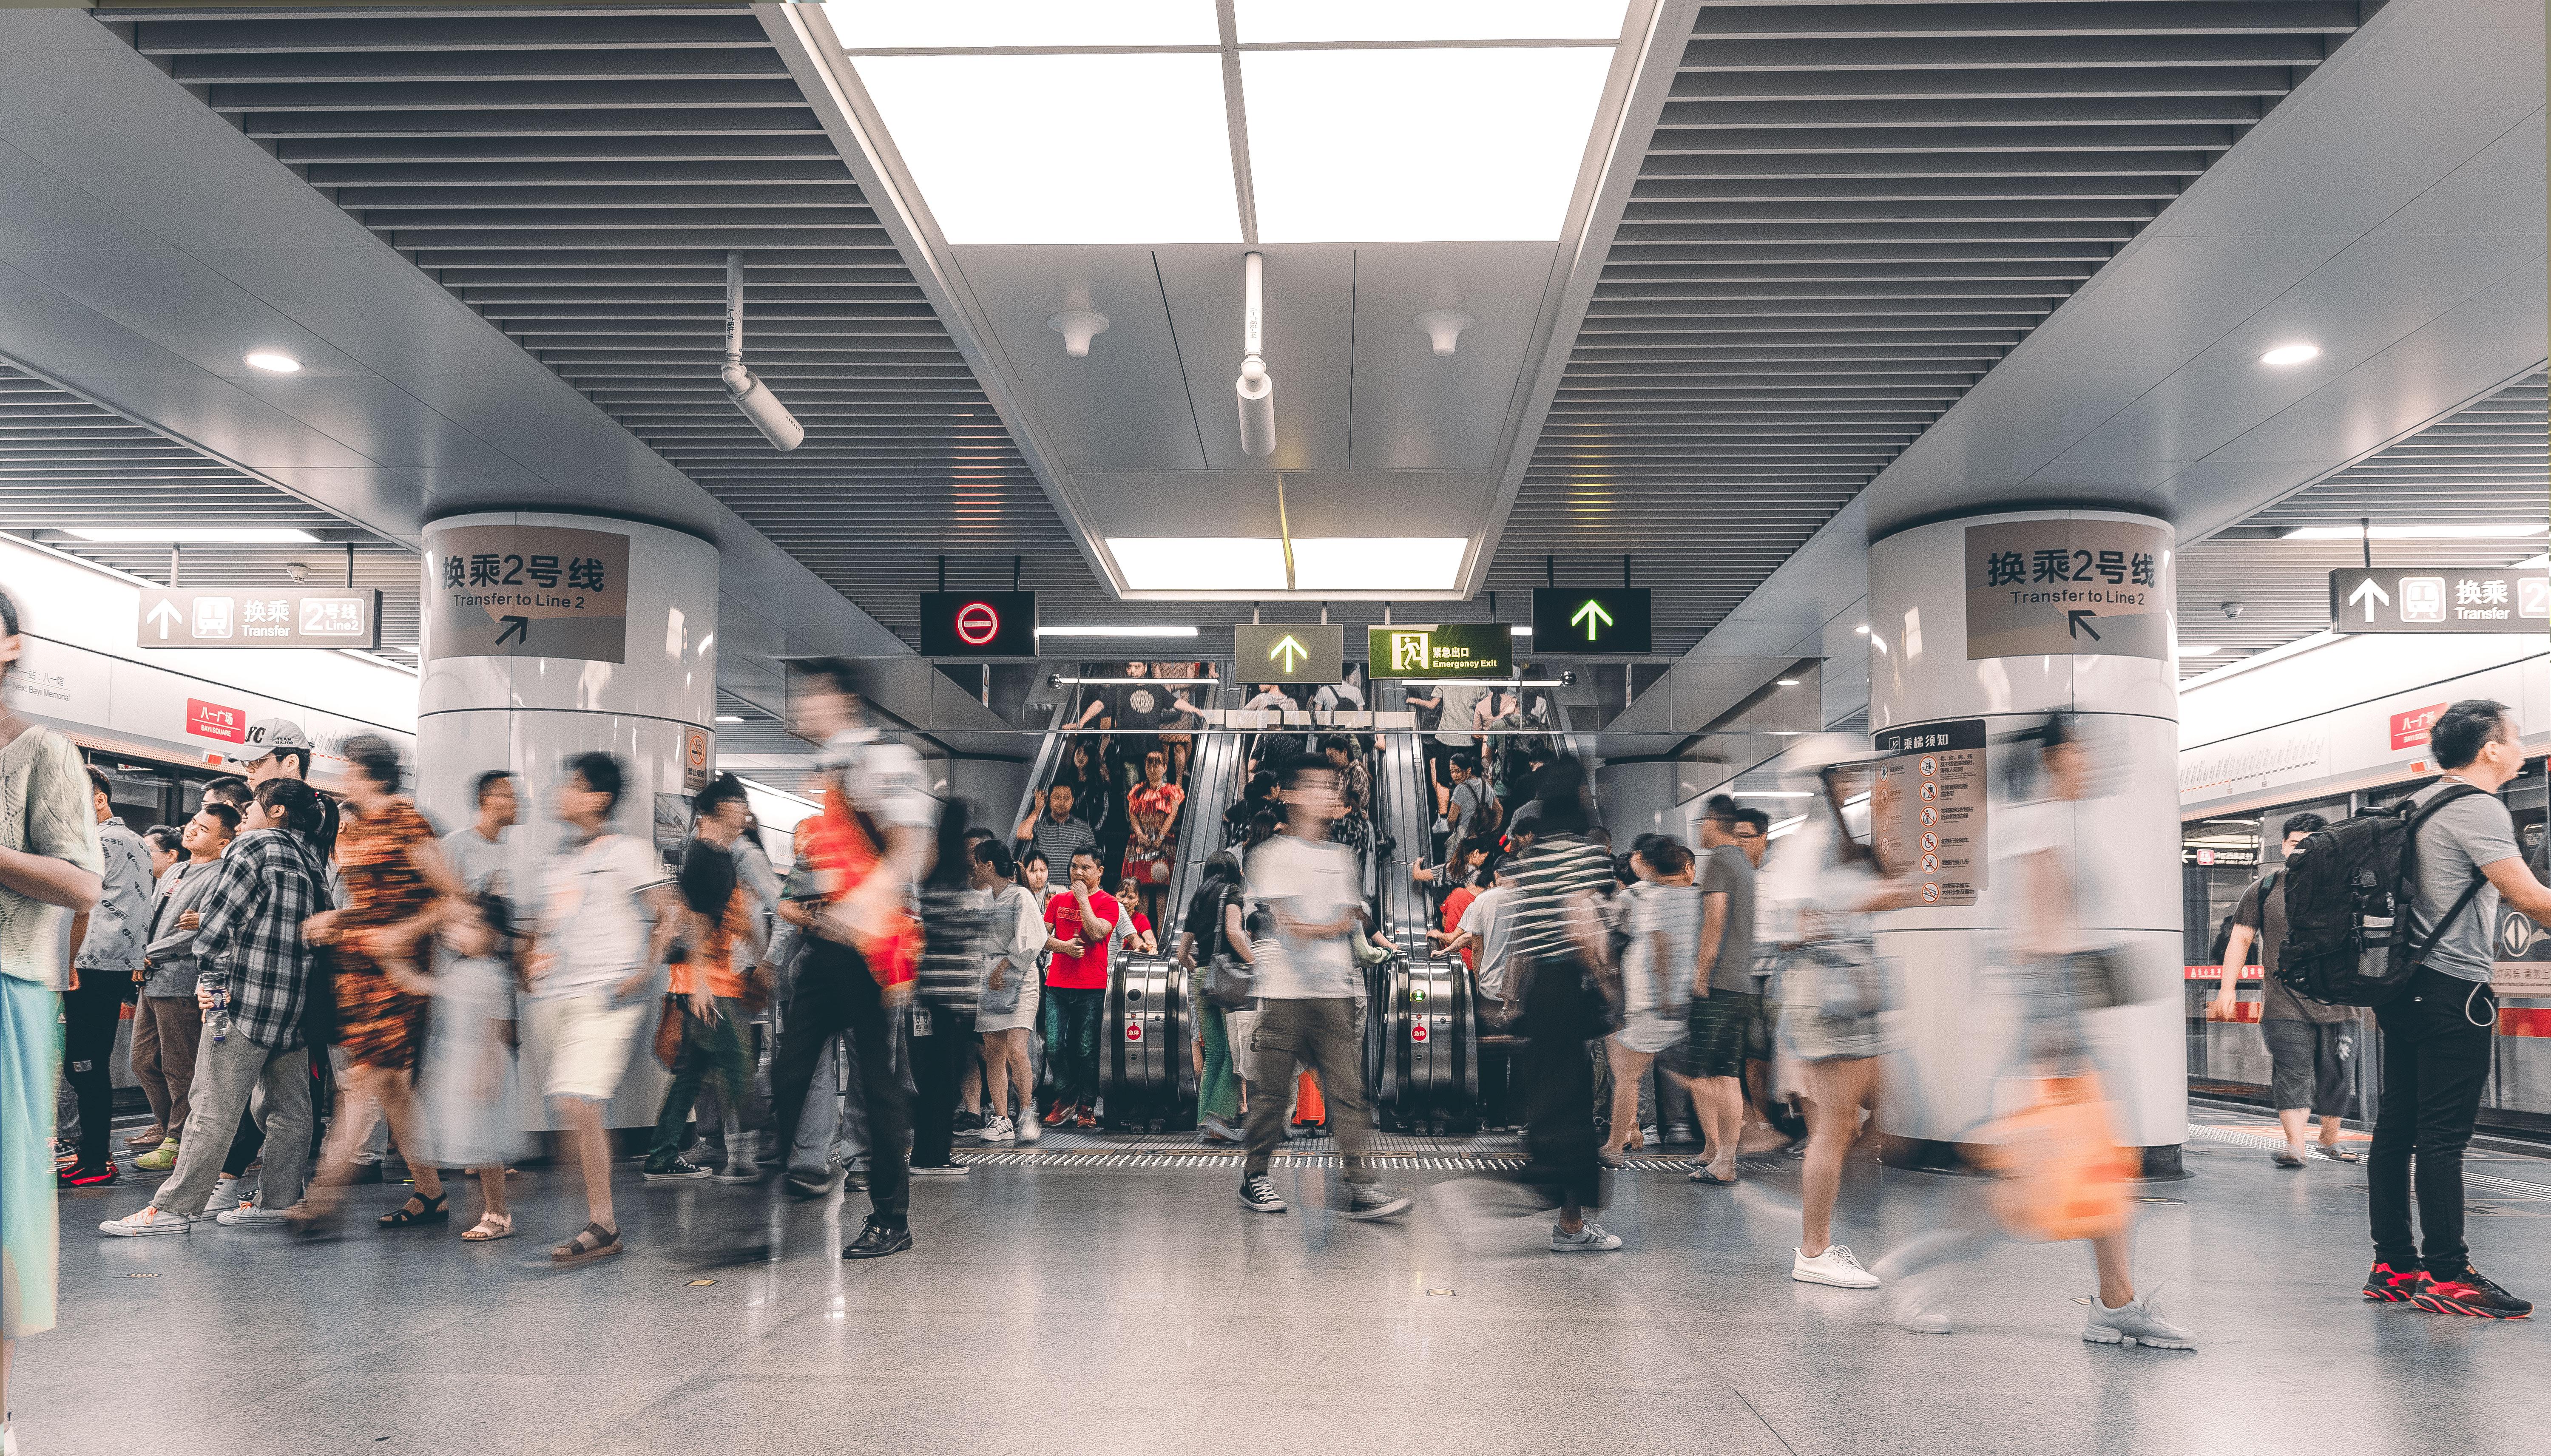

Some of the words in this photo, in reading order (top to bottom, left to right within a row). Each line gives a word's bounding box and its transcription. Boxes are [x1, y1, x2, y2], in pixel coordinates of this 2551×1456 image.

[442, 553, 605, 593] 换乘2号线
[1988, 549, 2155, 588] 换乘2号线
[2010, 590, 2084, 604] Transfer
[2088, 590, 2102, 602] to
[2107, 590, 2135, 604] Line
[2138, 593, 2145, 605] 2
[2454, 579, 2508, 605] 换乘
[454, 593, 512, 606] Transfer
[516, 593, 531, 606] to
[536, 595, 571, 608] Line
[575, 596, 585, 609] 2
[243, 599, 290, 623] 换乘
[304, 602, 357, 630] 2号线
[2453, 607, 2511, 620] Transfer
[241, 624, 291, 637] Transfer
[1432, 647, 1469, 658] 紧急出口
[1433, 660, 1479, 669] Emergency
[14, 682, 27, 692] Next
[29, 685, 42, 696] Bayi
[43, 688, 70, 701] Memorial
[200, 707, 233, 725] 八一广场
[201, 724, 212, 732] BAYI
[212, 727, 232, 737] SQUARE
[1903, 734, 1948, 750] 乘梯须知
[2524, 969, 2551, 979] 请勿上
